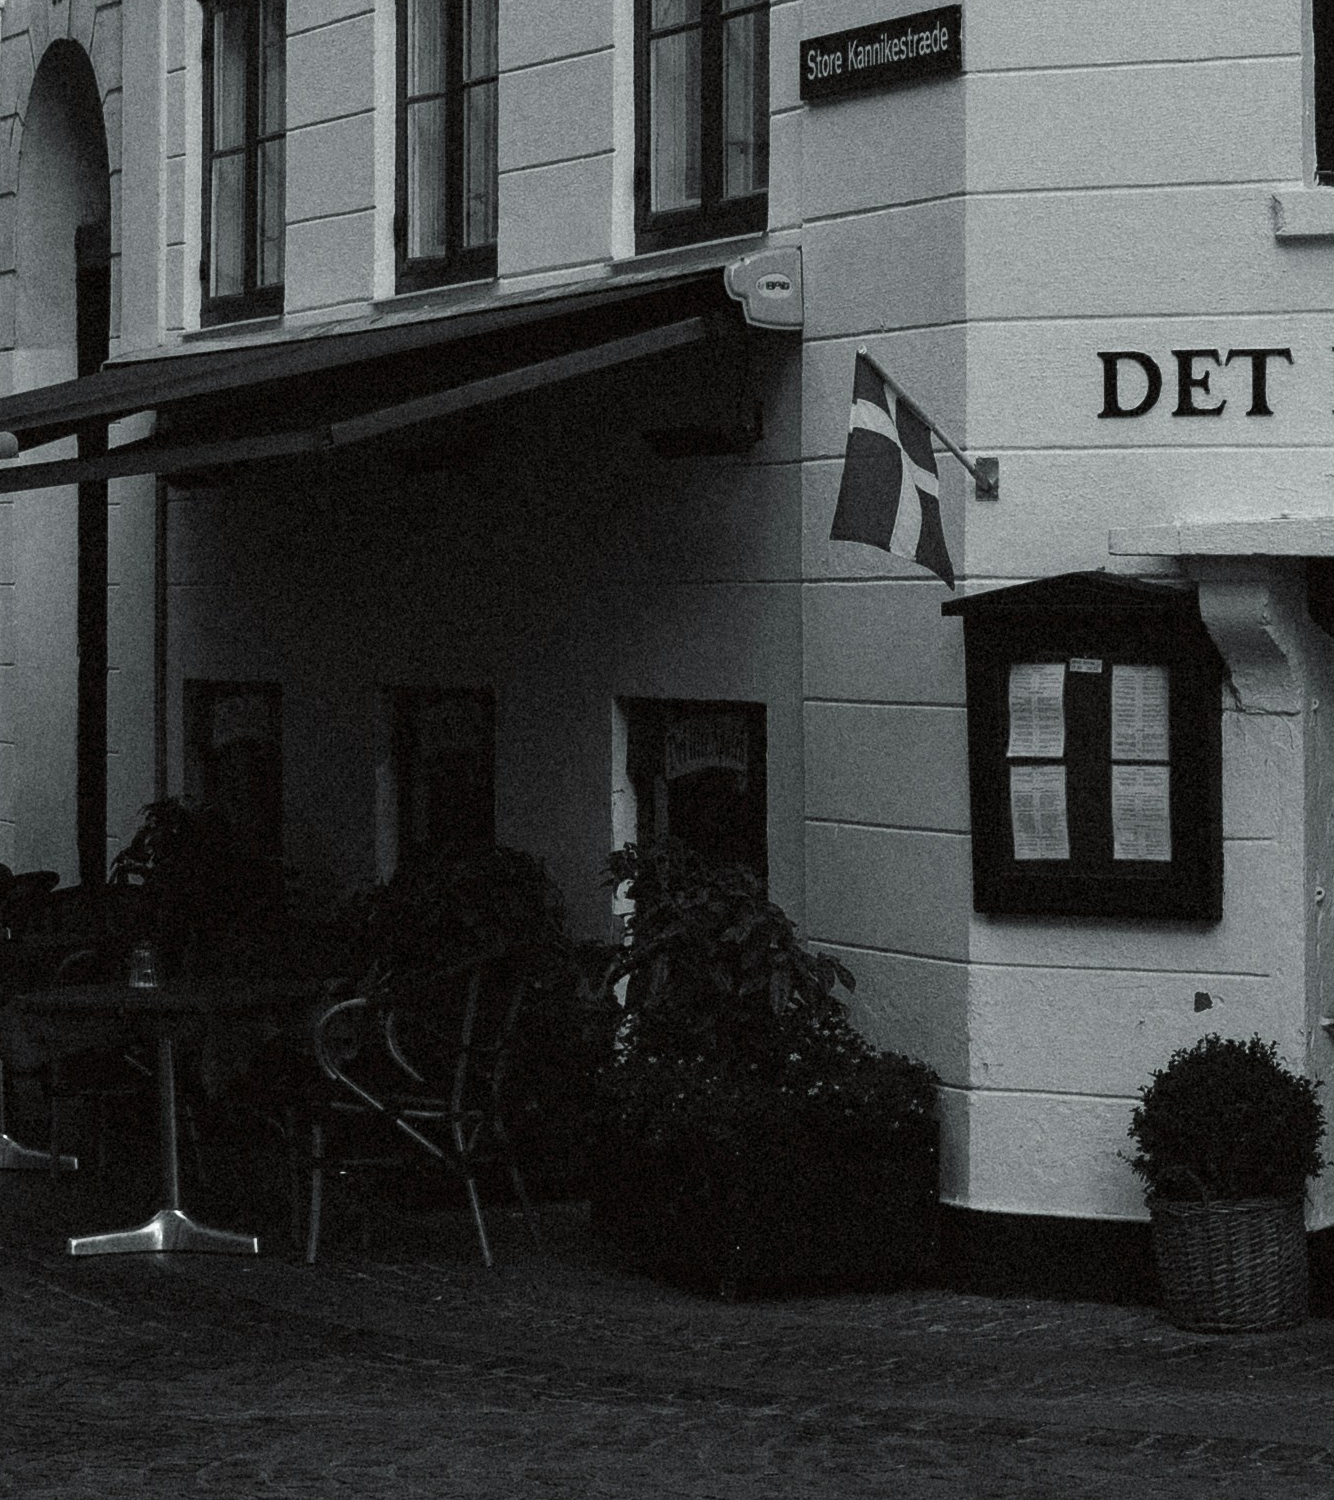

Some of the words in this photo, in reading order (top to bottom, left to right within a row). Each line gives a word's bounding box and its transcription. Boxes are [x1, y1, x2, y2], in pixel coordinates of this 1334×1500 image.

[806, 49, 843, 81] Store
[847, 20, 949, 72] Kannikestræde
[1096, 347, 1294, 419] DET
